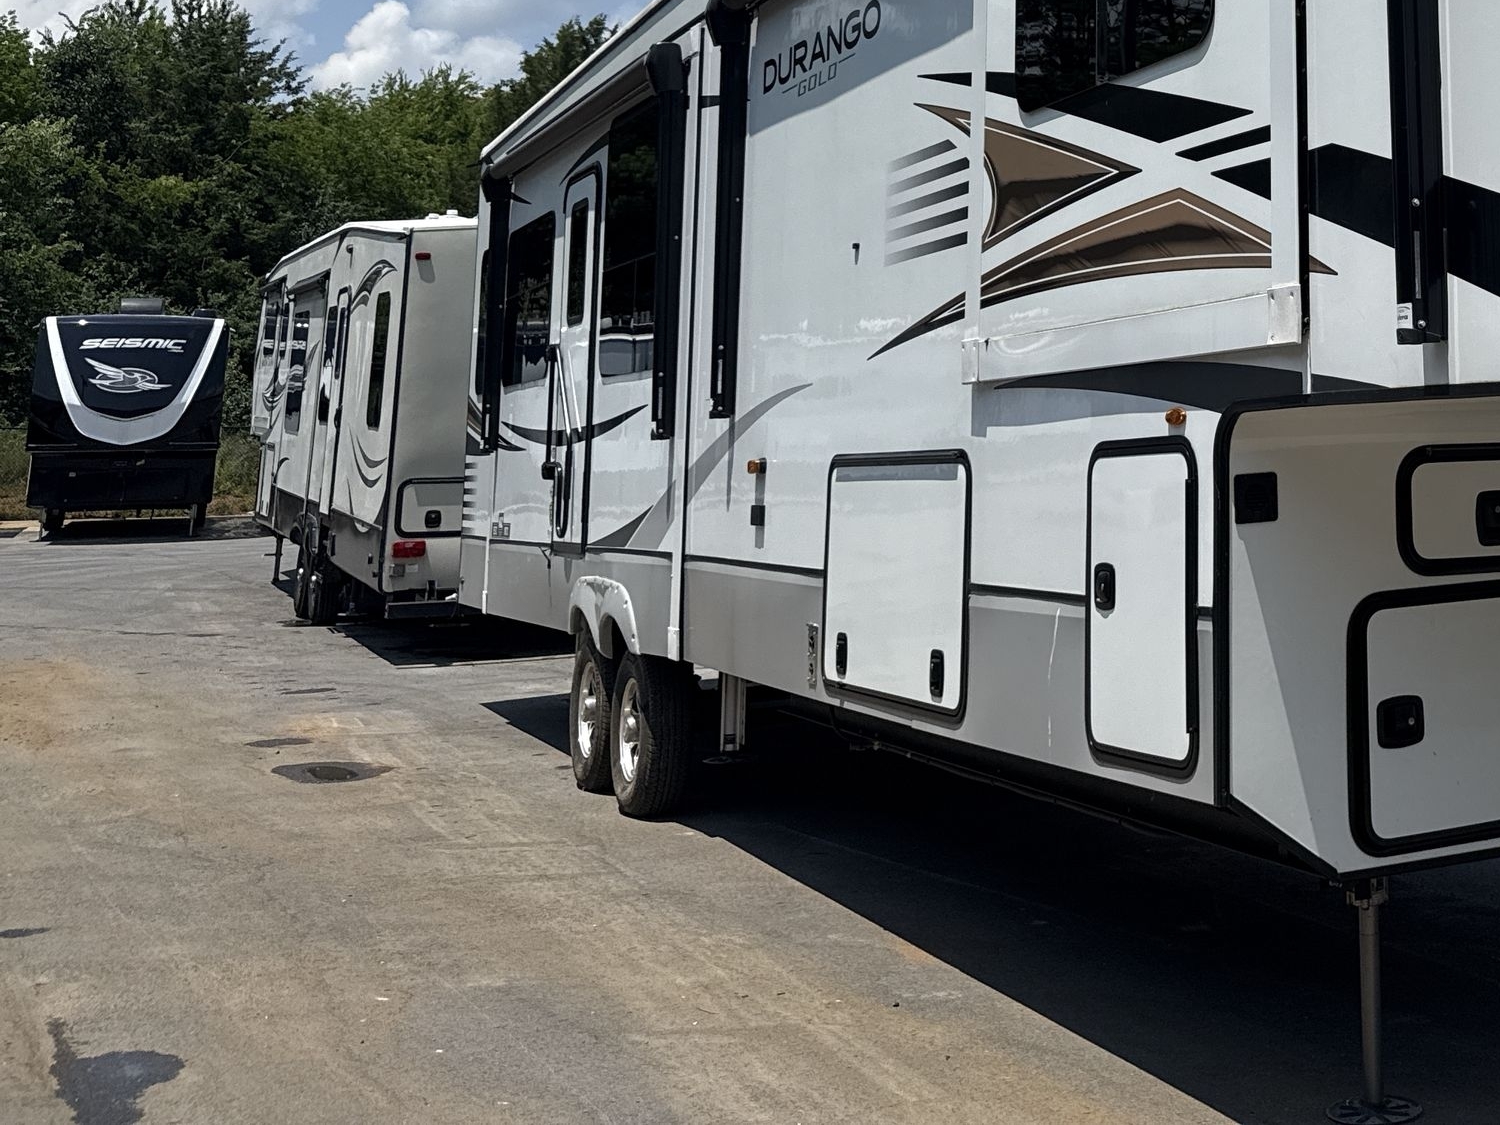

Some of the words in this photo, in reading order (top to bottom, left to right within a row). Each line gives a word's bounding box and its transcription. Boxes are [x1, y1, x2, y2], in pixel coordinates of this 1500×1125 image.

[763, 0, 882, 94] DURANGO
[797, 62, 838, 97] GOLD
[79, 337, 187, 350] SEISMIC
